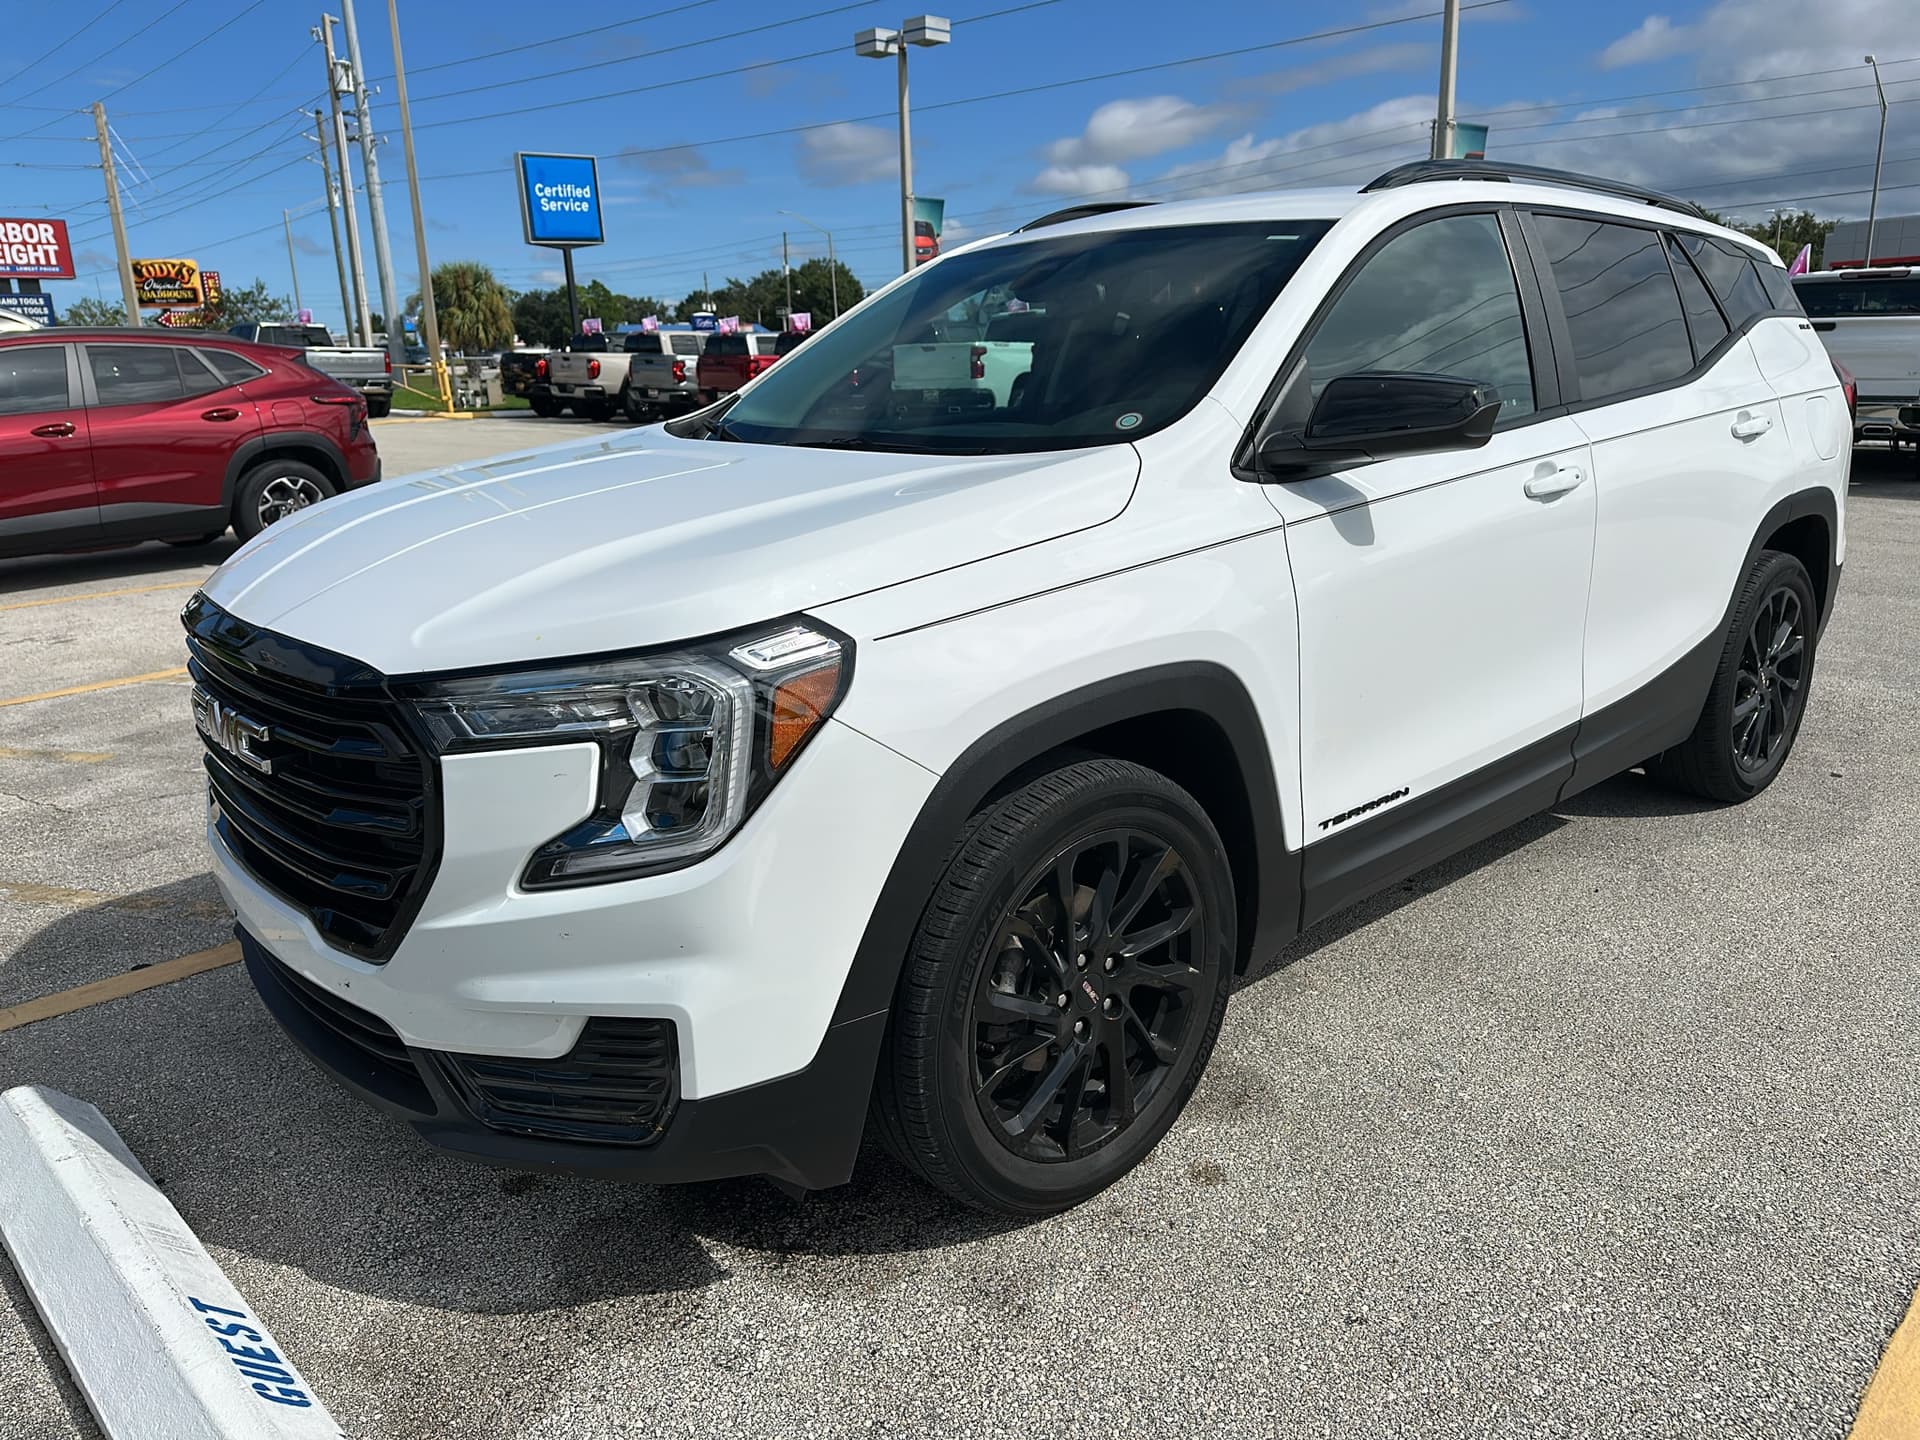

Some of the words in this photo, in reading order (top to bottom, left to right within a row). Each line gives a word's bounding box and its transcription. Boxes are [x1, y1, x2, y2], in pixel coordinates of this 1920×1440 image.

[534, 183, 591, 198] Certified
[541, 198, 589, 212] Service
[0, 243, 59, 265] IGHT
[144, 278, 182, 293] Original
[19, 297, 44, 305] TOOLS
[191, 684, 272, 775] GMC
[1318, 787, 1409, 830] TERRAIN
[188, 1296, 312, 1408] GUEST
